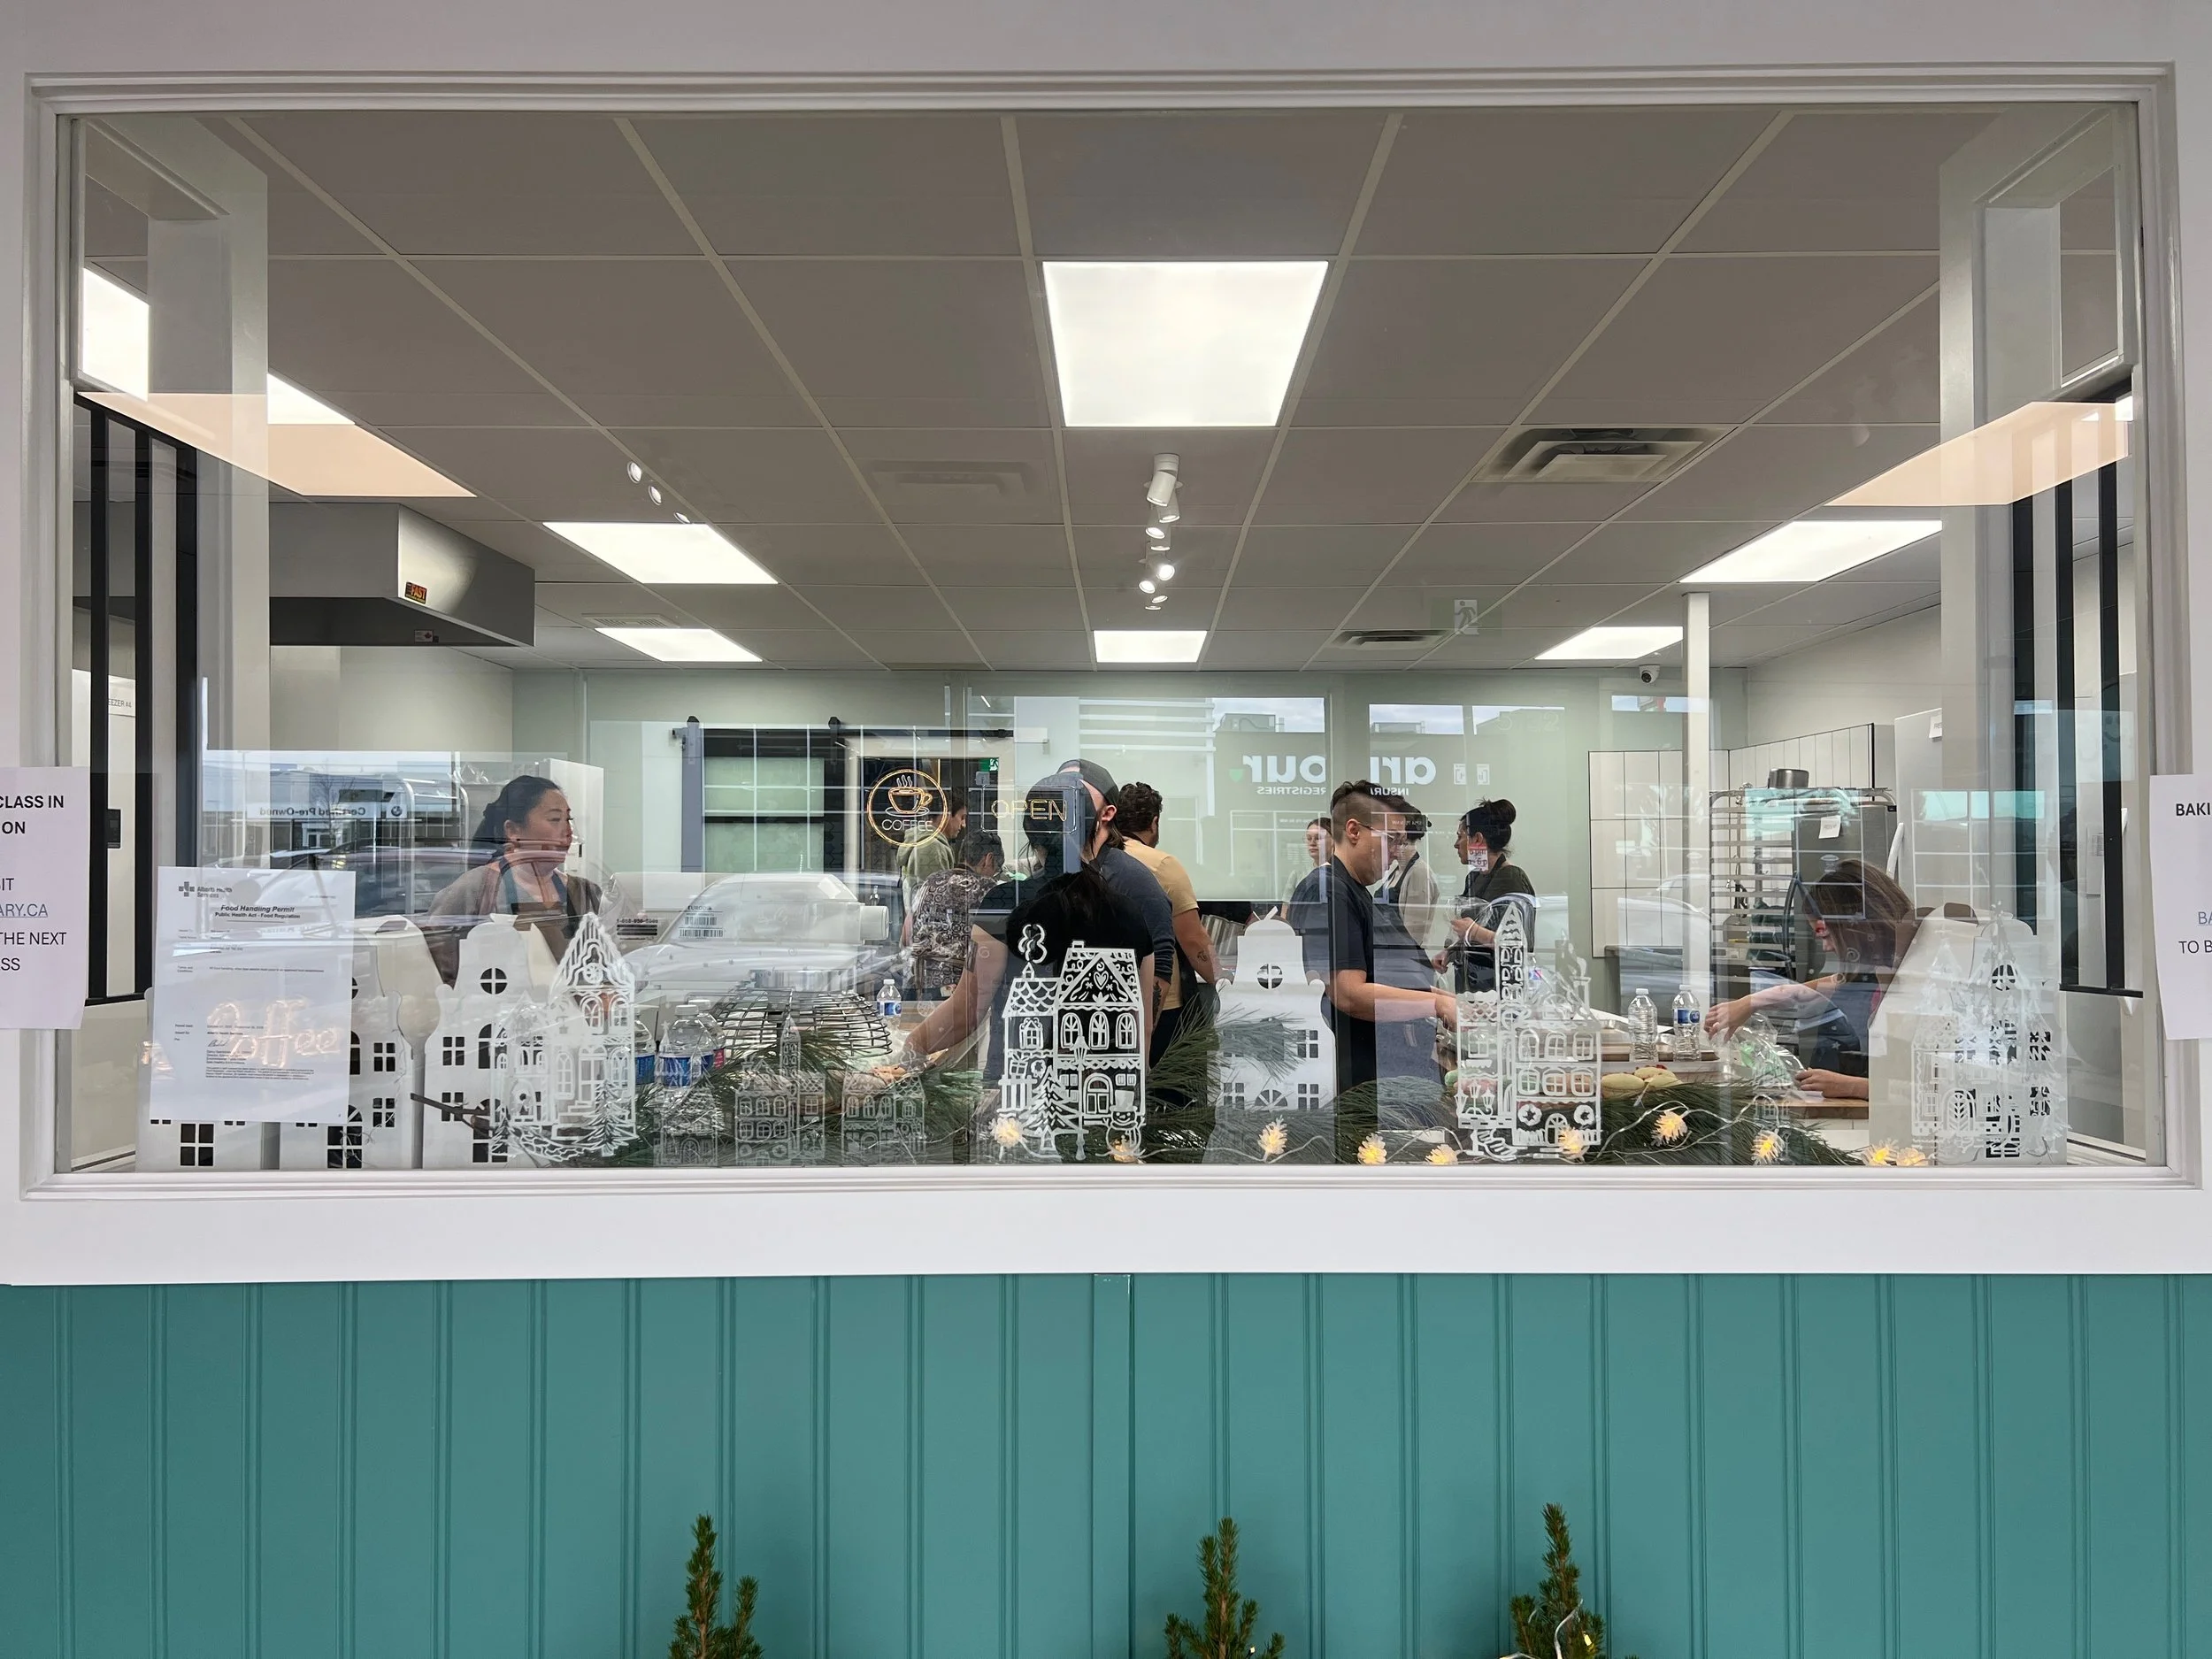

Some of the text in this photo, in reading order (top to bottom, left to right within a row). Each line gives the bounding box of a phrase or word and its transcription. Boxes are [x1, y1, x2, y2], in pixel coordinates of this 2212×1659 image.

[48, 795, 64, 809] IN
[990, 798, 1067, 823] OPEN
[2, 820, 26, 834] ON
[881, 818, 933, 832] COFFEE
[0, 878, 14, 891] IT
[240, 904, 271, 914] Handling
[29, 932, 67, 945] NEXT
[2177, 940, 2200, 954] TO
[0, 957, 20, 971] SS
